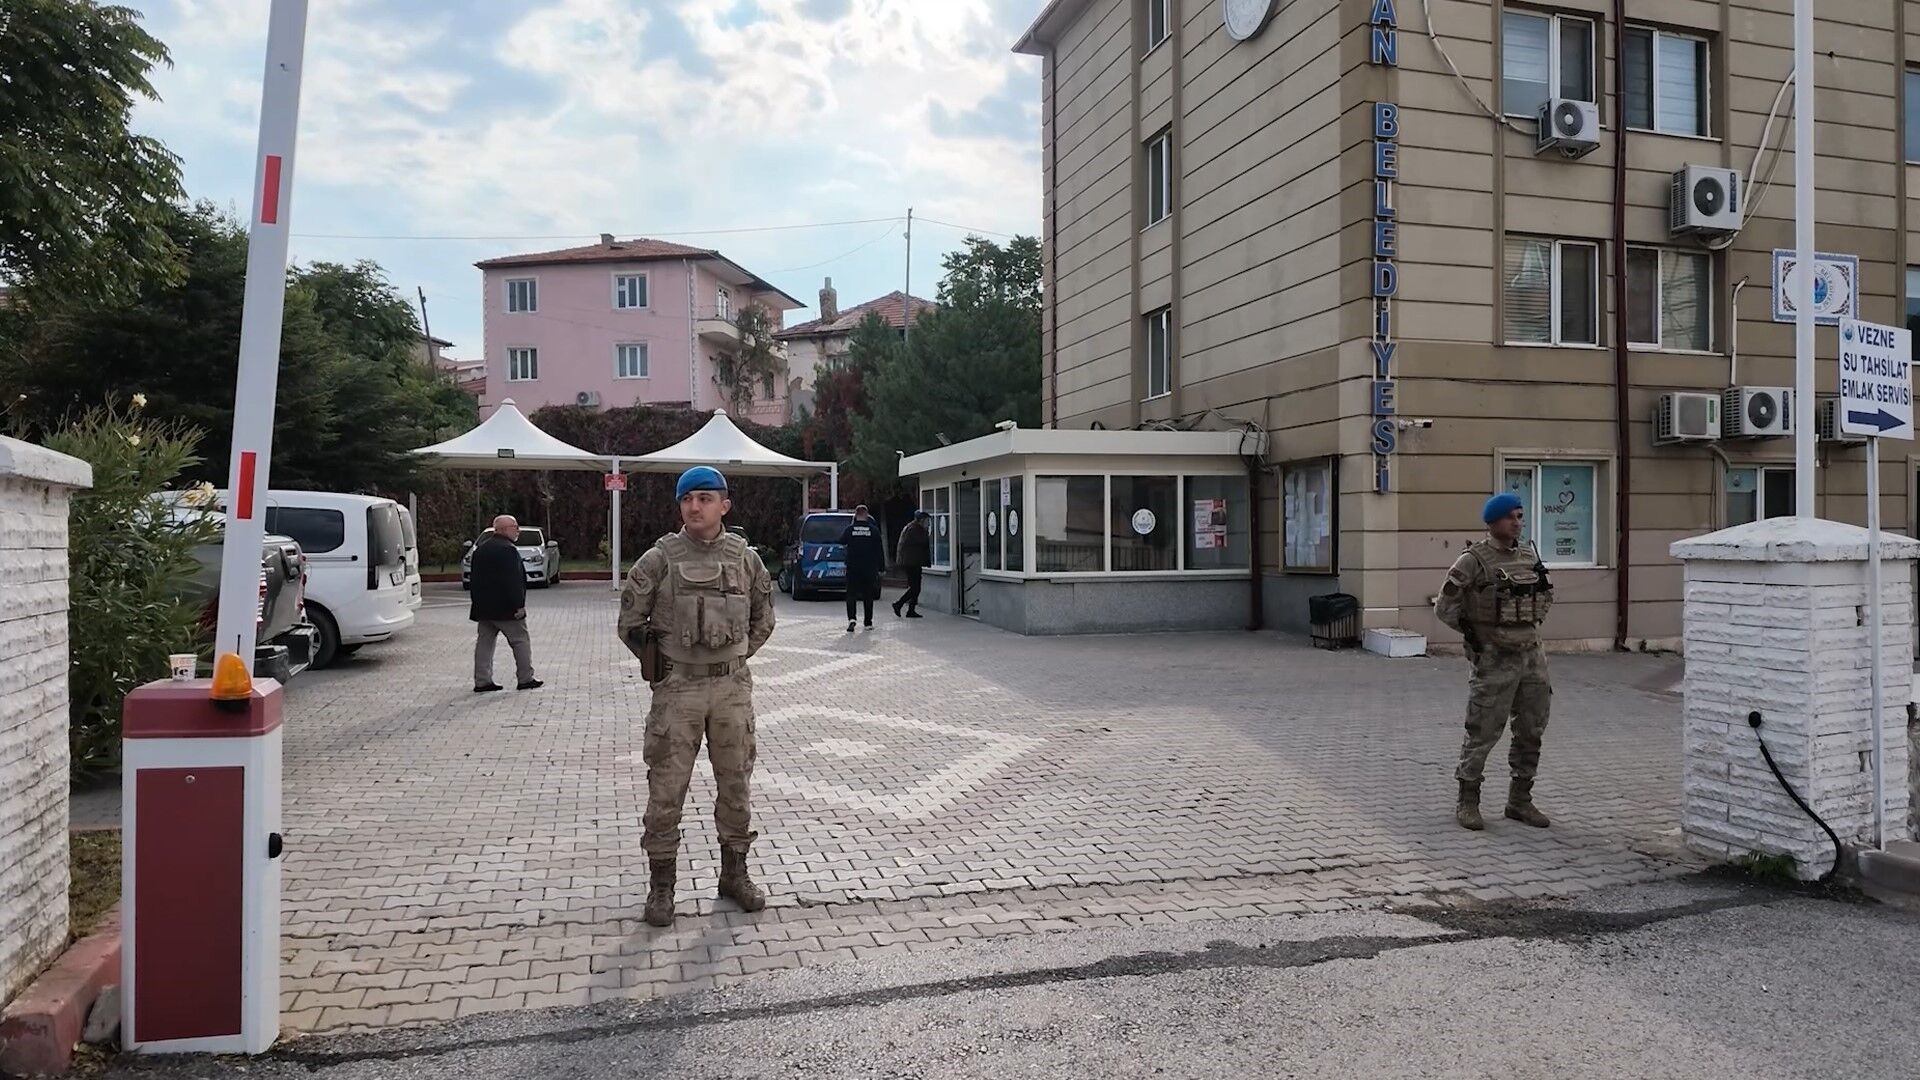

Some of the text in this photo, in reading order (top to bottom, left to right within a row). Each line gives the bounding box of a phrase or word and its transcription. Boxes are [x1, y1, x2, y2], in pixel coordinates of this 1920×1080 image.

[1370, 0, 1399, 494] AN BELEDİYESİ
[1858, 325, 1895, 349] VEZNE
[1843, 352, 1908, 380] SU TAHSİLAT
[1841, 378, 1911, 407] EMLAK SERVİSİ
